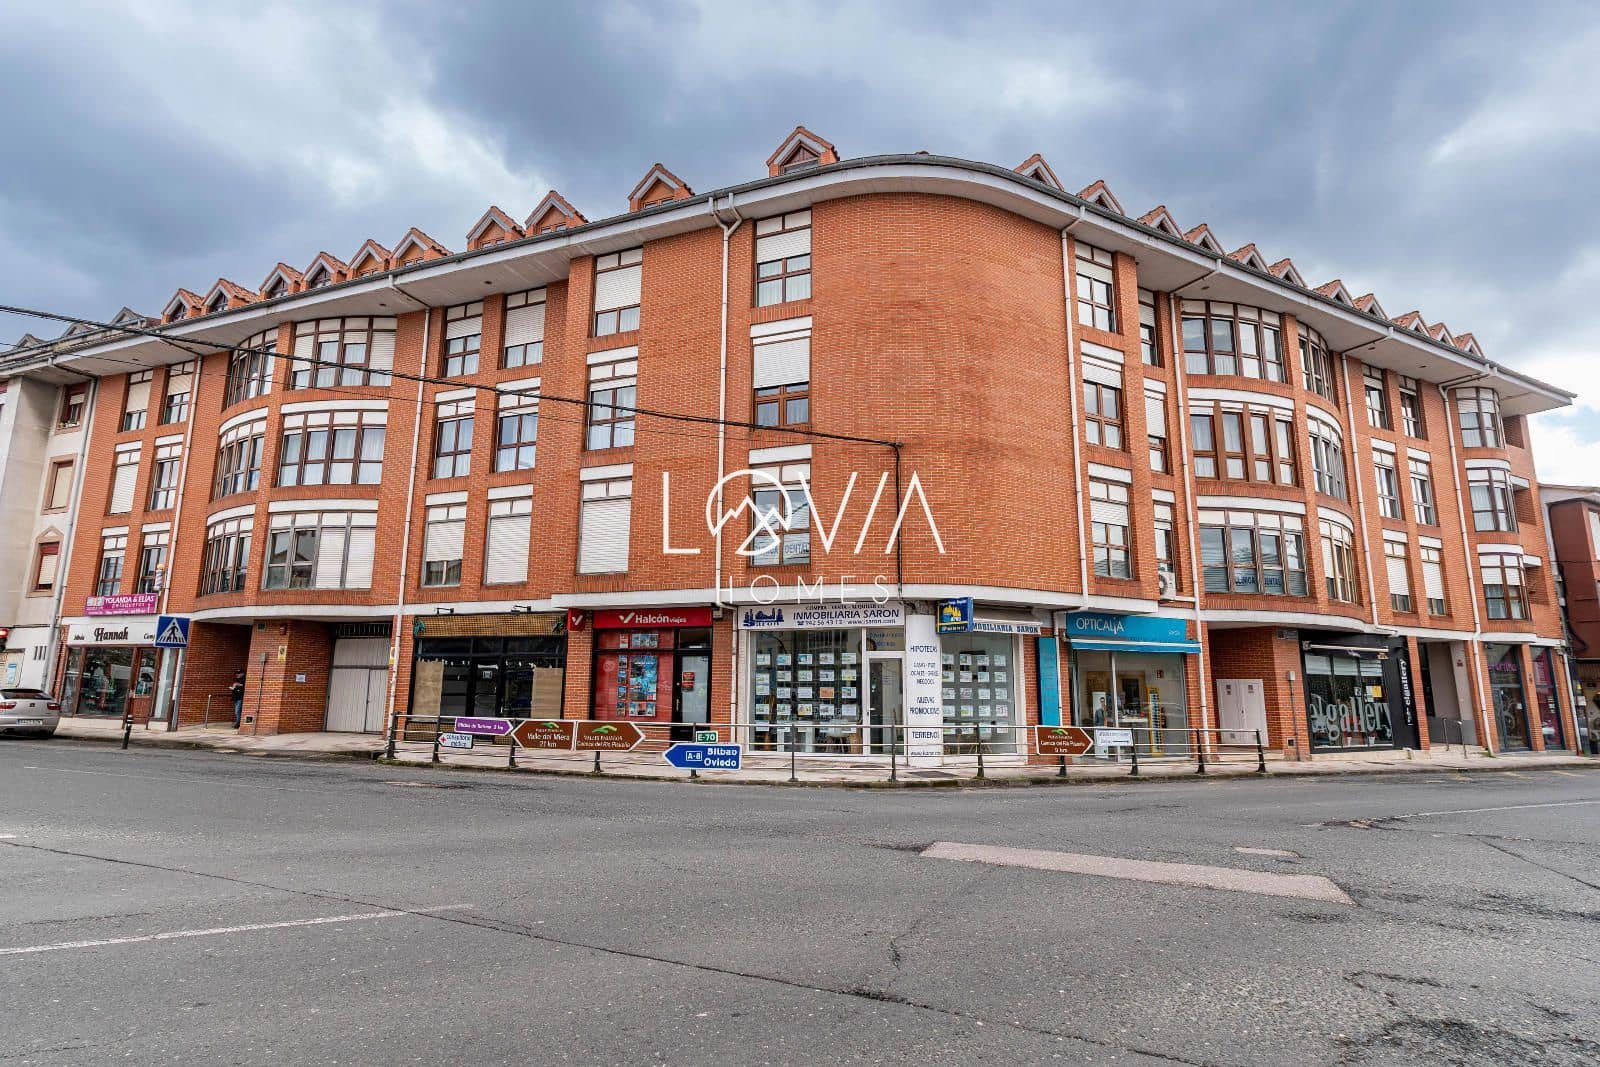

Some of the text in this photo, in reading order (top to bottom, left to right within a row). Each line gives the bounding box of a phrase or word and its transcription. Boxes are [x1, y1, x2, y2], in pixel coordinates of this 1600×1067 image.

[635, 614, 670, 624] Halcón
[793, 609, 900, 620] INMOBILIARIA SARON
[1076, 617, 1124, 634] OPTICALIA
[94, 626, 129, 642] Hannah
[707, 748, 738, 756] Bilbao
[704, 758, 737, 767] Oviedo
